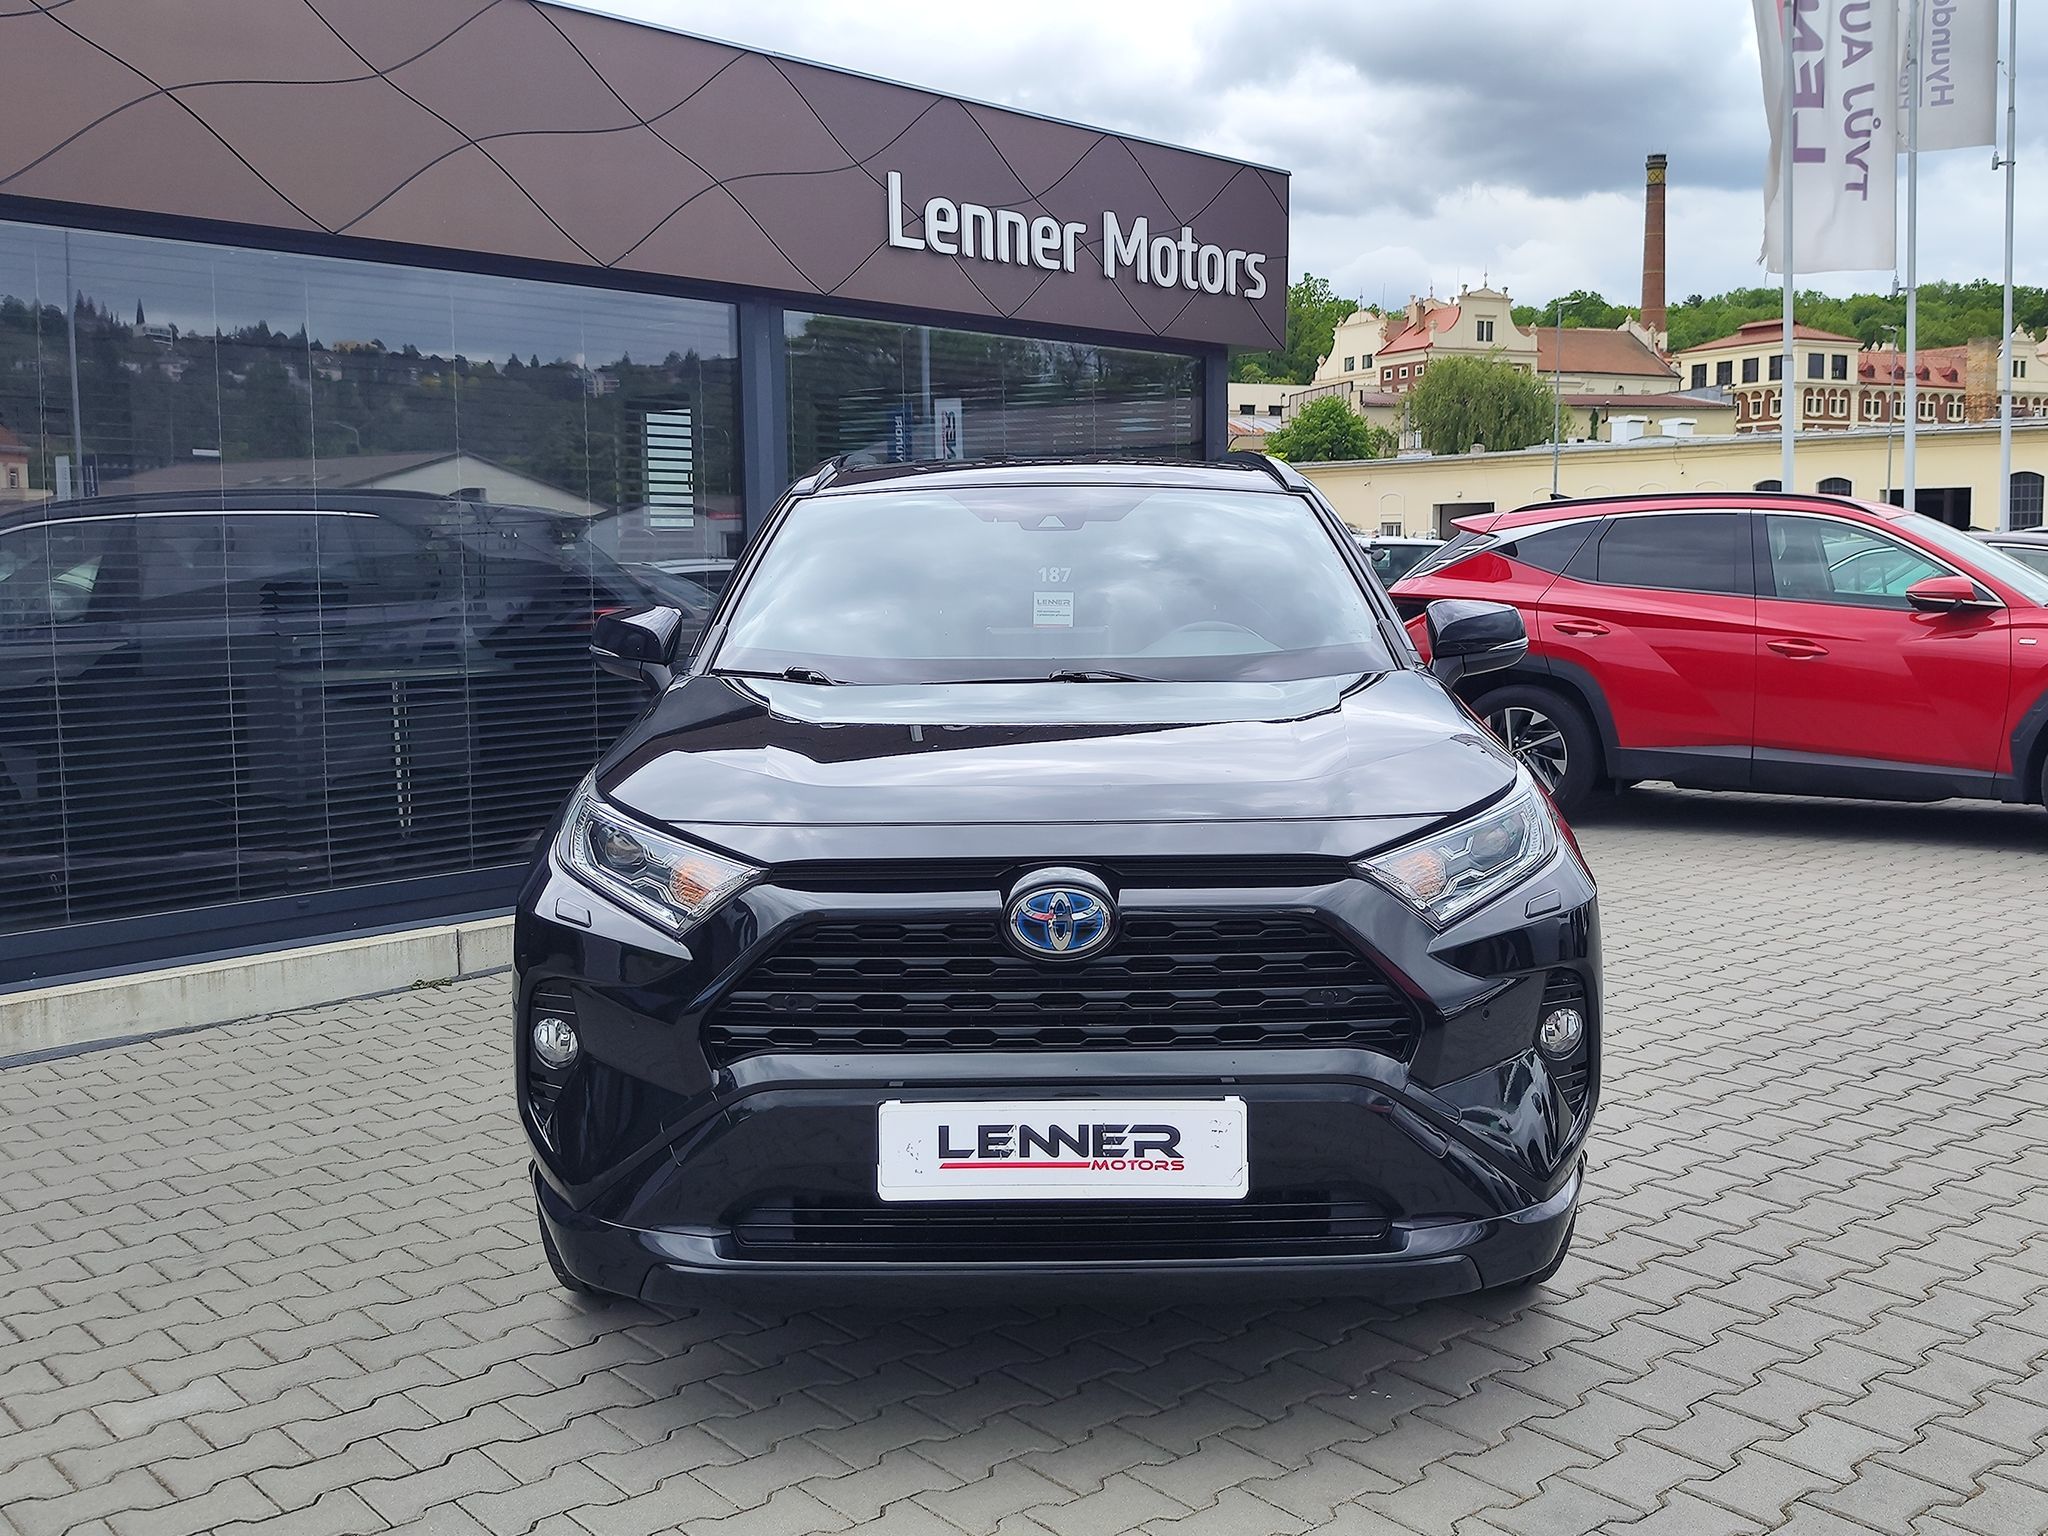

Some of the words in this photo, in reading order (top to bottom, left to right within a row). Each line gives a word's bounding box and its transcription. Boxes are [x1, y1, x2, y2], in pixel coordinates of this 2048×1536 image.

[887, 170, 1087, 274] Lenner
[1102, 210, 1267, 300] Motors
[1038, 566, 1072, 583] 187
[938, 1123, 1184, 1159] LENNER
[1091, 1159, 1185, 1171] MOTORS
